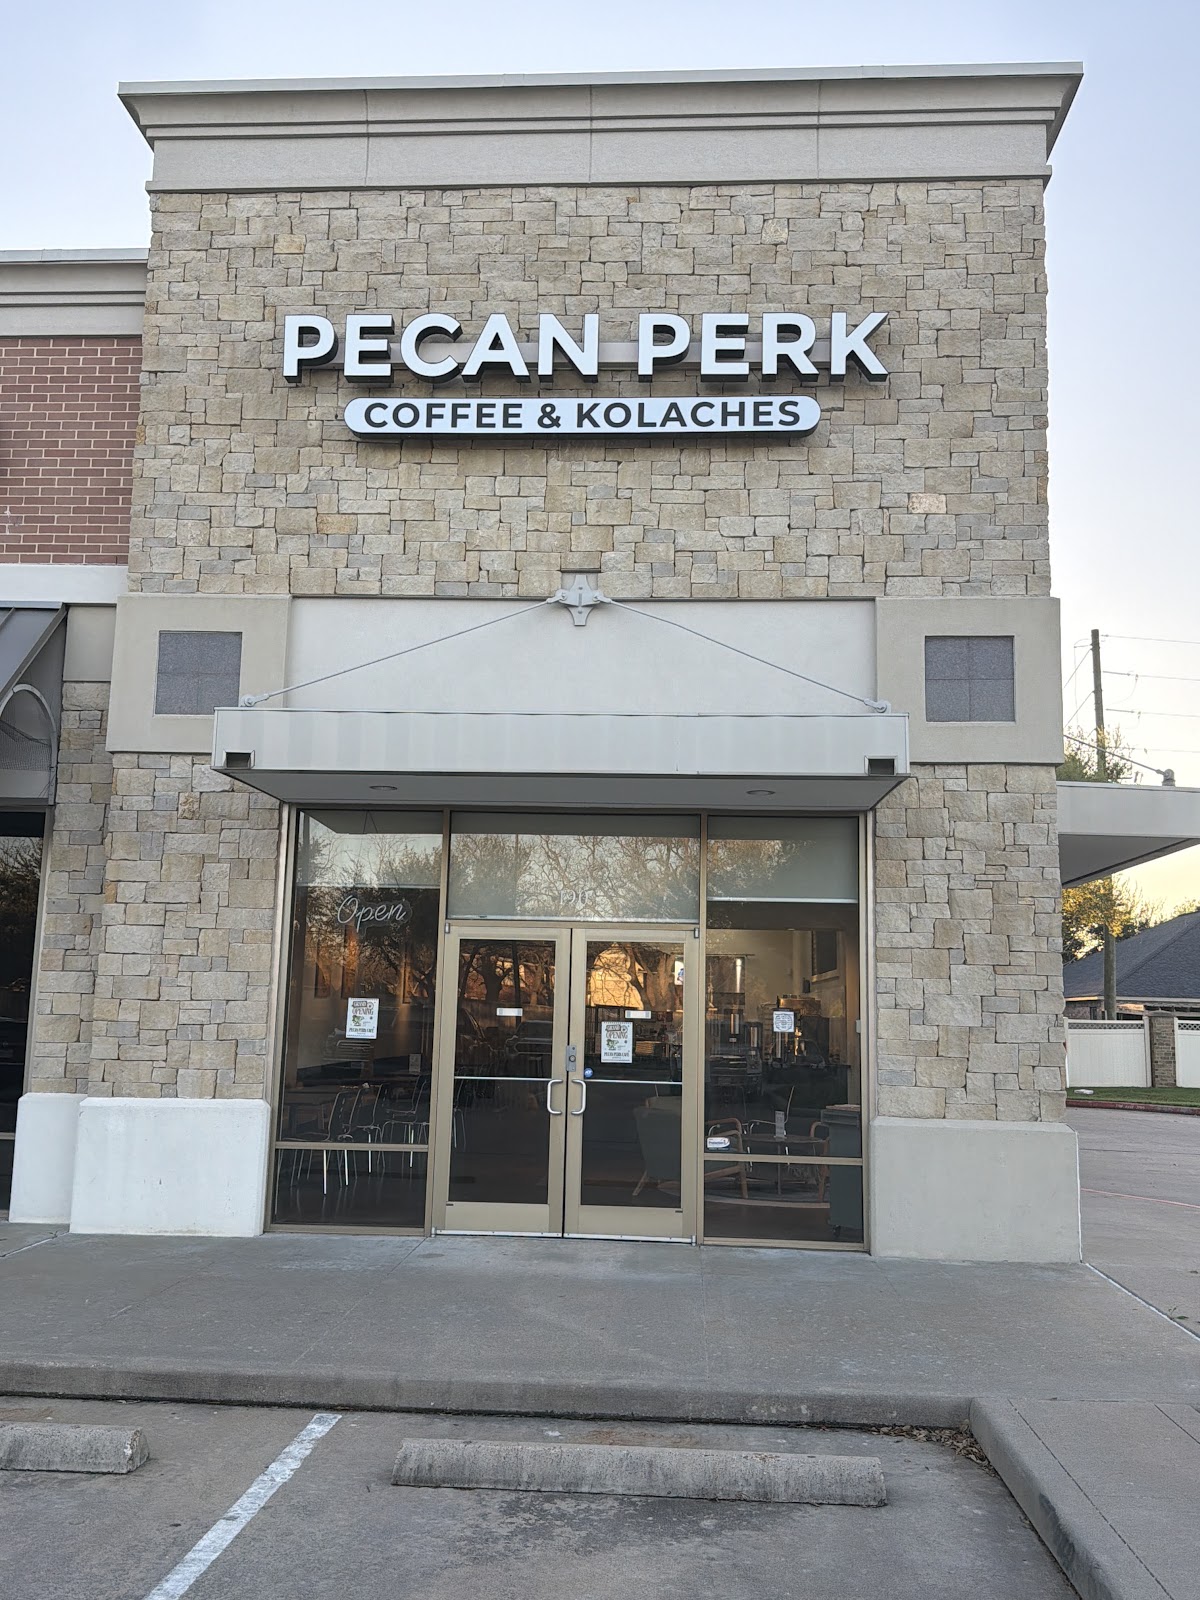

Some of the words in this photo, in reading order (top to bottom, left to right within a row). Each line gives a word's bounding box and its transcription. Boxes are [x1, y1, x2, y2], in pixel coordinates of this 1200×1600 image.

[283, 312, 600, 381] PECAN
[638, 312, 889, 380] PERK
[364, 402, 523, 428] COFFEE
[537, 403, 561, 428] &
[576, 400, 800, 428] KOLACHES
[337, 894, 407, 933] Open
[352, 1007, 374, 1015] OPENING
